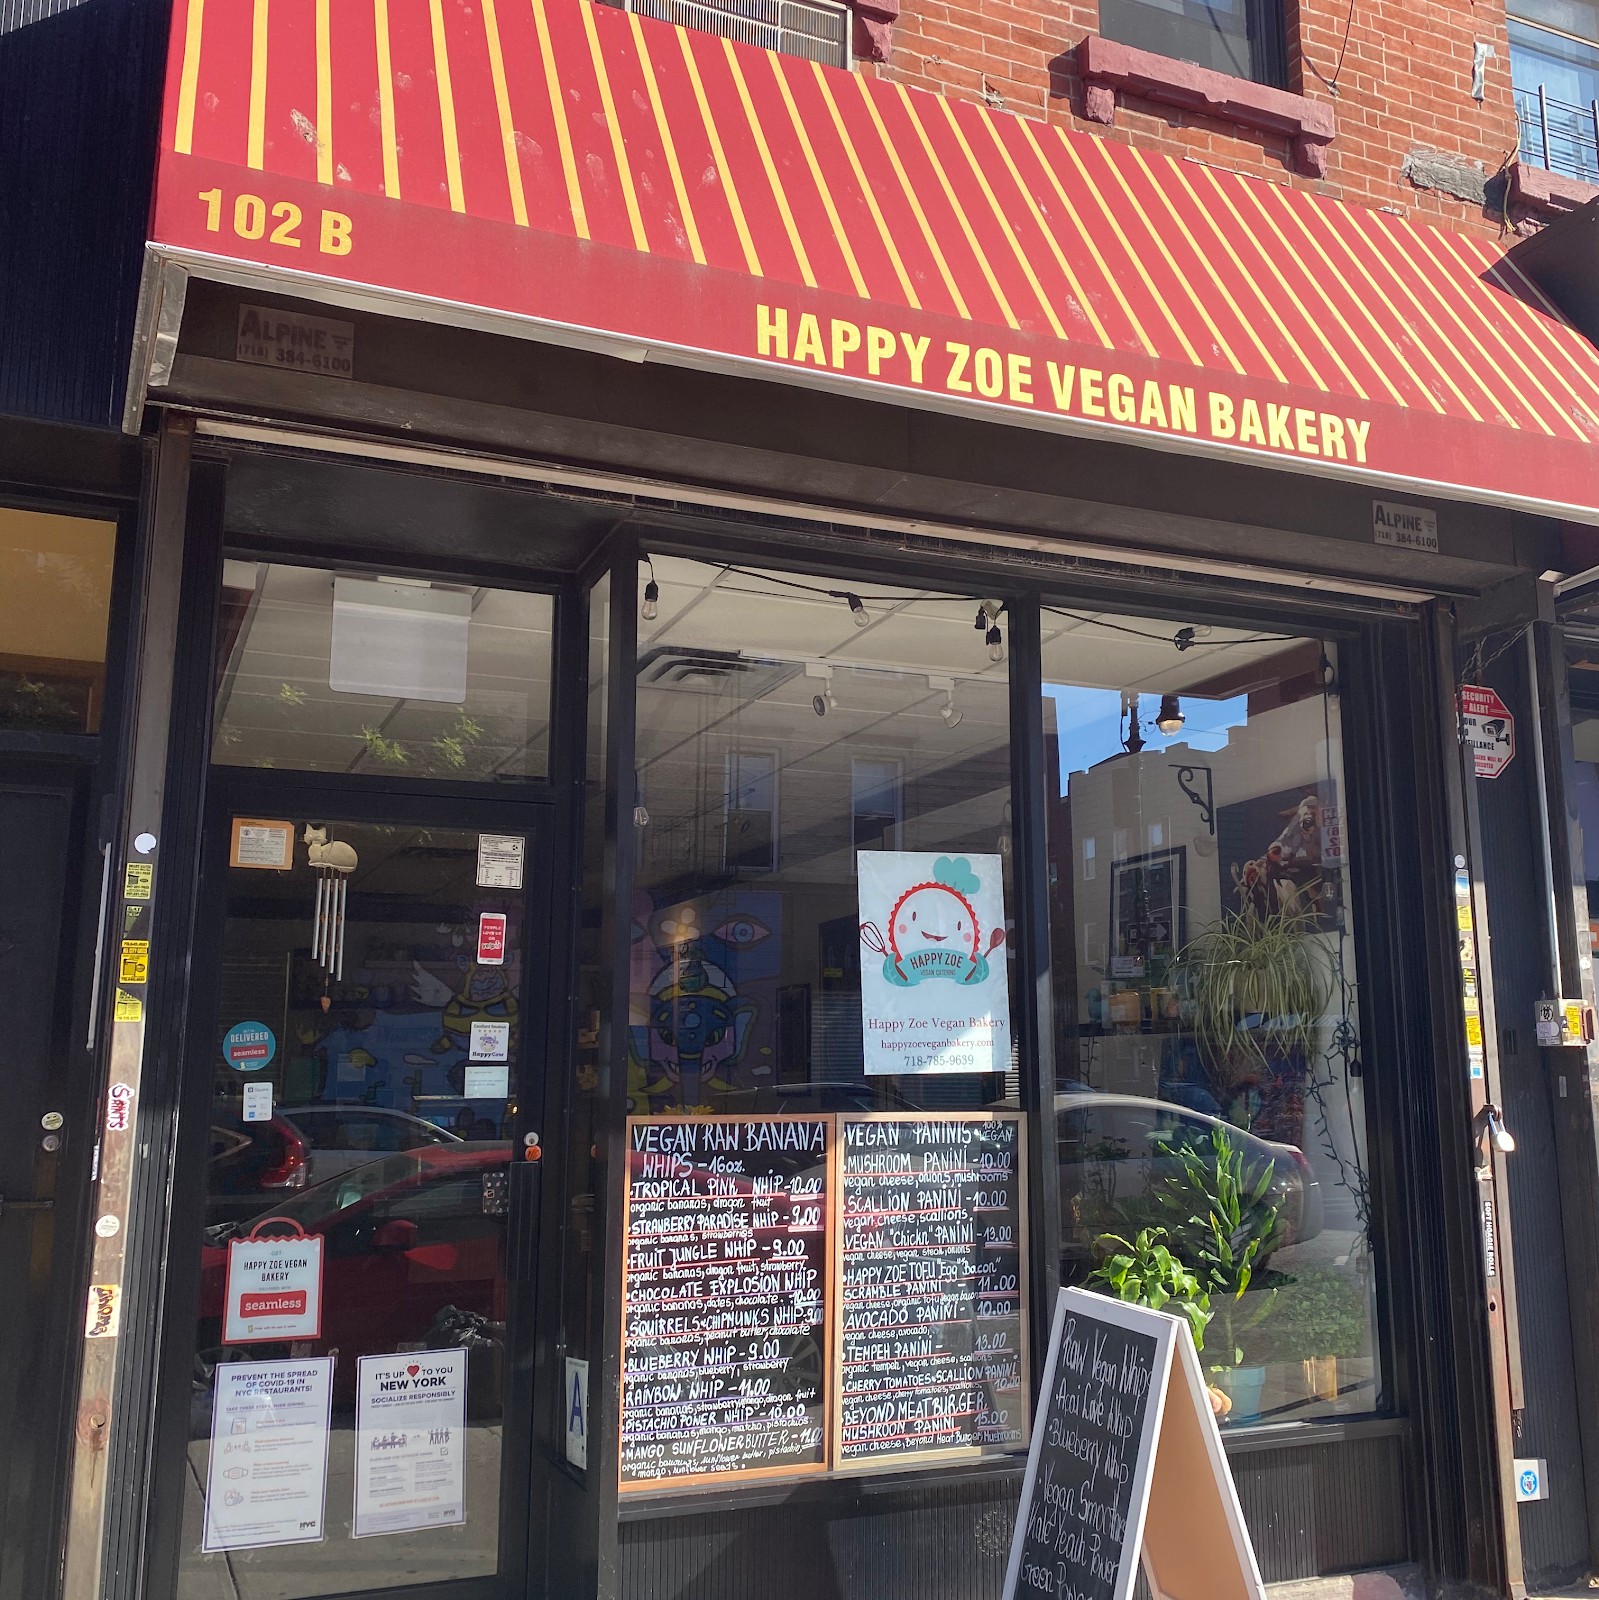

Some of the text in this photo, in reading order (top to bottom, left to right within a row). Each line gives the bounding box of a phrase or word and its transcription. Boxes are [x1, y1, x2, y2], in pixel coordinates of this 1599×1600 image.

[198, 187, 354, 256] 102 B
[756, 304, 1371, 464] HAPPY ZOE VEGAN BAKERY
[1462, 690, 1495, 704] SECURITY
[1469, 704, 1489, 714] ALERT
[910, 952, 964, 969] HAPPY ZOE
[868, 1017, 1005, 1032] Happy Zoe Vegan Bakery
[230, 1031, 269, 1043] DELIVERED
[881, 1038, 995, 1051] happyzoeveganbakery.com
[233, 1049, 265, 1057] seamless
[904, 1055, 974, 1067] 718-785-9639
[633, 1121, 824, 1152] VEGAN RAW BANANA
[847, 1121, 971, 1146] VEGAN PANINIS
[979, 1129, 1013, 1142] VEGAN
[982, 1121, 1003, 1130] 100%
[642, 1151, 693, 1178] WHIPS
[848, 1145, 967, 1174] MUSHROOM PANINI
[632, 1179, 701, 1198] TROPICAL
[707, 1174, 738, 1196] PINK
[844, 1174, 876, 1195] vegan
[954, 1169, 1009, 1182] mushrooms
[630, 1200, 665, 1217] organic
[713, 1197, 745, 1214] dragon
[848, 1183, 962, 1213] SCALLION PANINI
[1485, 1201, 1493, 1220] SOFT
[631, 1214, 696, 1235] STRAWBERRY
[697, 1213, 748, 1231] PARADISE
[845, 1230, 884, 1250] VEGAN
[935, 1217, 974, 1244] PANINI
[1486, 1221, 1494, 1251] HOAGIE
[243, 1259, 308, 1270] HAPPY ZOE VEGAN
[630, 1247, 666, 1269] FRUIT
[668, 1243, 718, 1270] JUNGLE
[261, 1272, 289, 1281] BAKERY
[846, 1261, 936, 1286] HAPPY ZOE TOFU
[630, 1280, 703, 1302] CHOCOLATE
[709, 1272, 781, 1296] EXPLOSION
[844, 1284, 901, 1300] SCRAMBLE
[906, 1275, 942, 1294] PANINI
[245, 1299, 302, 1311] seamless
[845, 1310, 908, 1330] AVOCADO
[916, 1301, 957, 1322] PANINI
[629, 1314, 700, 1337] SQUIRRELS
[846, 1342, 890, 1361] TEMPEH
[894, 1335, 932, 1358] PANINI
[1063, 1318, 1089, 1376] Raw
[1092, 1328, 1117, 1394] Vegan
[627, 1349, 699, 1373] BLUEBERRY
[231, 1373, 268, 1382] PREVENT
[286, 1370, 318, 1378] SPREAD
[258, 1379, 295, 1388] COVID-19
[375, 1366, 453, 1381] IT'S UP TO YOU
[380, 1376, 446, 1392] NEW YORK
[846, 1378, 882, 1393] CHERRY
[883, 1374, 931, 1390] TOMATOES
[935, 1362, 983, 1383] SCALLION
[235, 1385, 313, 1397] NYC RESTAURANTS!
[371, 1395, 408, 1404] SOCIALIZE
[408, 1390, 456, 1400] RESPONSIBLY
[625, 1383, 682, 1408] RAINBOW
[569, 1372, 583, 1436] A
[844, 1403, 894, 1425] BEYOND
[898, 1397, 932, 1420] MEAT
[625, 1412, 677, 1433] PISTACHIO
[914, 1417, 955, 1433] PANINI
[1107, 1396, 1133, 1460] Whip
[625, 1444, 665, 1461] MANGO
[672, 1435, 745, 1457] SUNFLOWER
[1049, 1418, 1129, 1508] Blueberry Whip
[1043, 1461, 1075, 1526] Vegan
[299, 1521, 316, 1529] NYC
[1027, 1502, 1051, 1544] Kale
[1089, 1533, 1120, 1586] Power
[1020, 1552, 1054, 1592] Green
